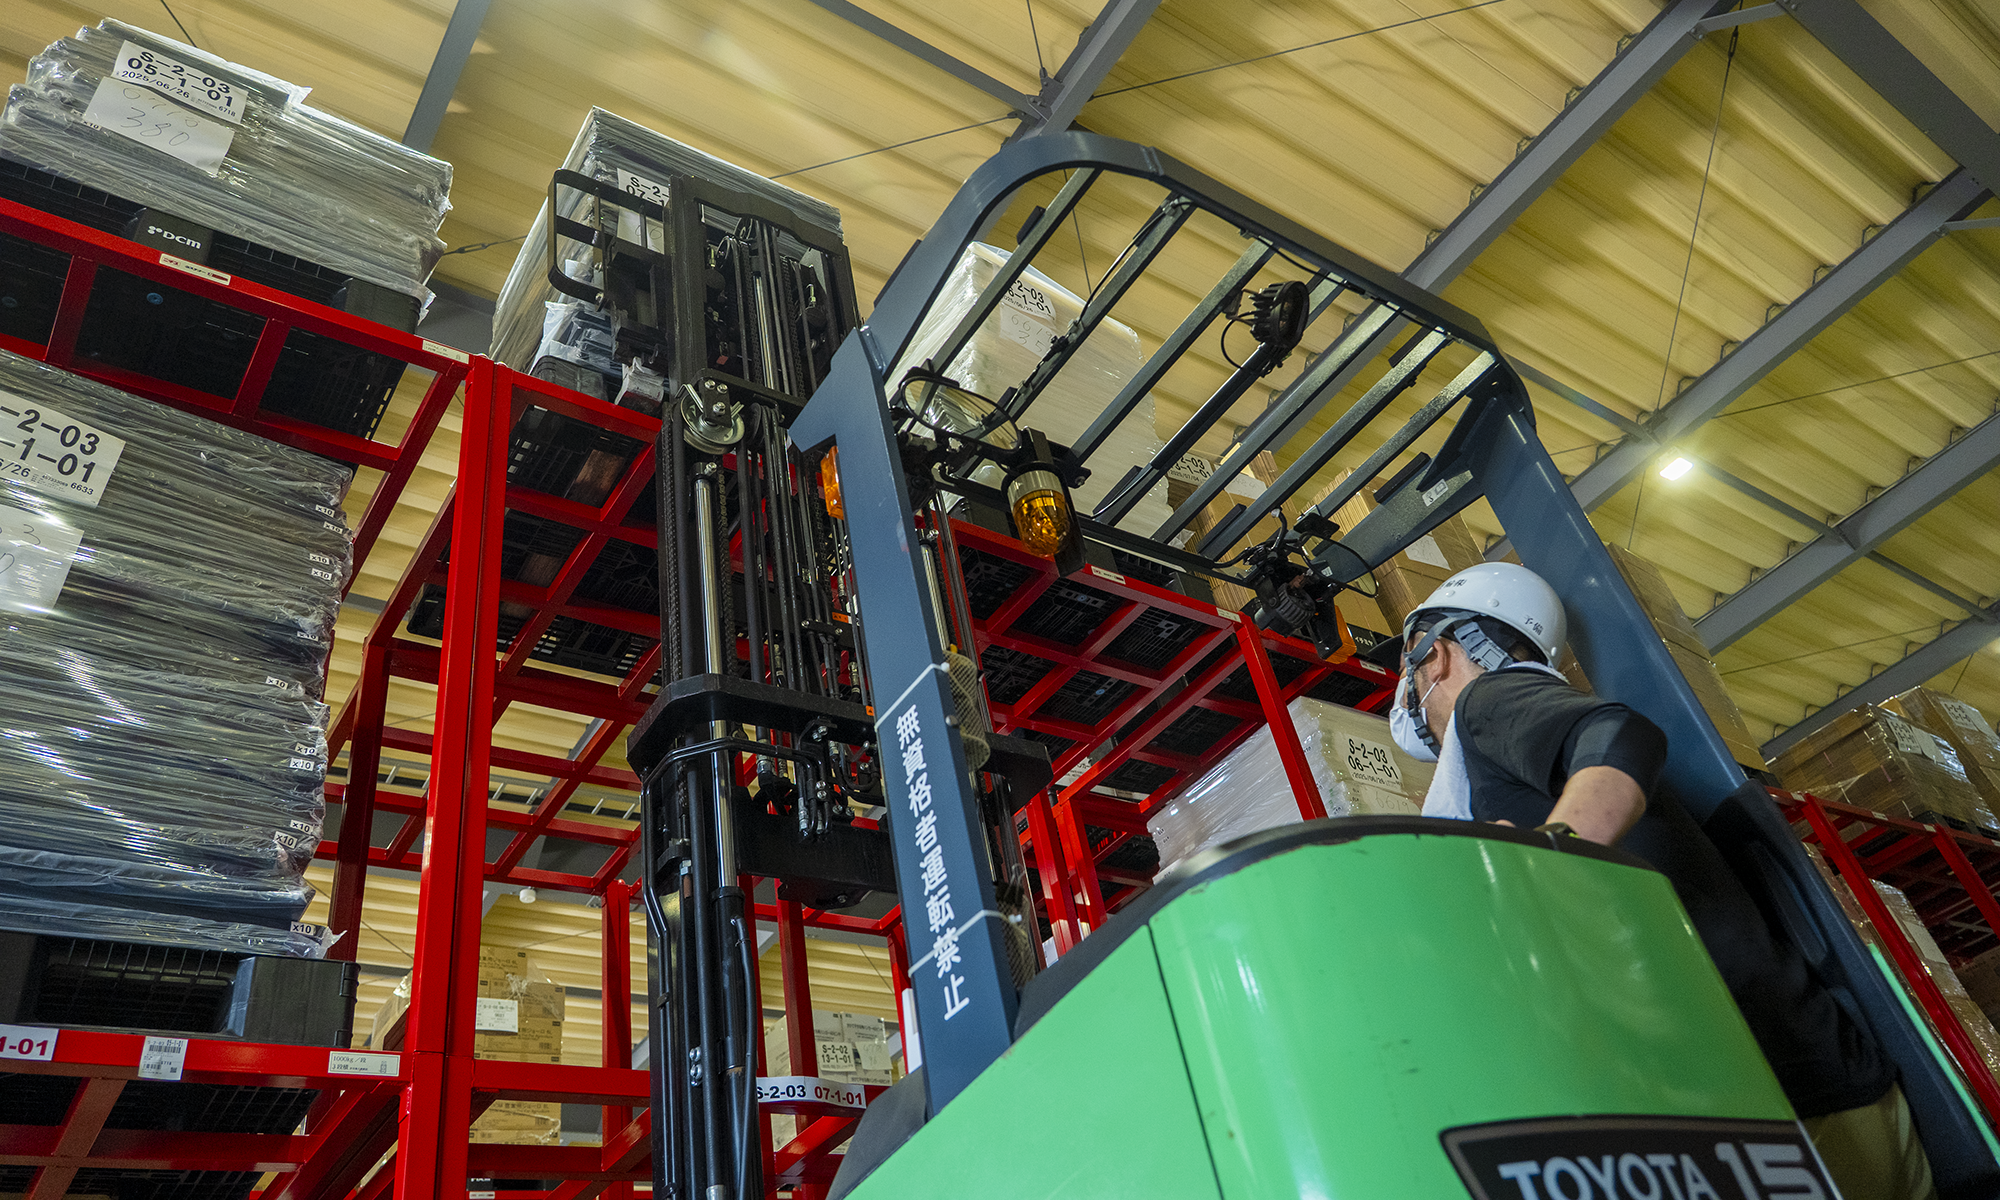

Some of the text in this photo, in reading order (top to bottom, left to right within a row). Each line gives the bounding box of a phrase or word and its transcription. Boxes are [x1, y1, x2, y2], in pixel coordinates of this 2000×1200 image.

[127, 57, 234, 107] 05-1-01
[139, 51, 231, 94] S-2-03
[121, 70, 190, 99] 2025/06/26
[218, 105, 236, 117] 6718
[70, 482, 94, 496] 6633
[1348, 738, 1388, 764] S-2-03
[1348, 755, 1399, 780] 06-1-01
[276, 834, 294, 846] x10
[896, 703, 970, 1021] 無資格者運転禁止
[293, 924, 311, 934] x10
[821, 1054, 851, 1064] 13-1-01
[822, 1044, 848, 1054] S-2-02
[757, 1085, 863, 1106] S-2-03 07-1-01
[1497, 1141, 1827, 1200] TOYOTA 15
